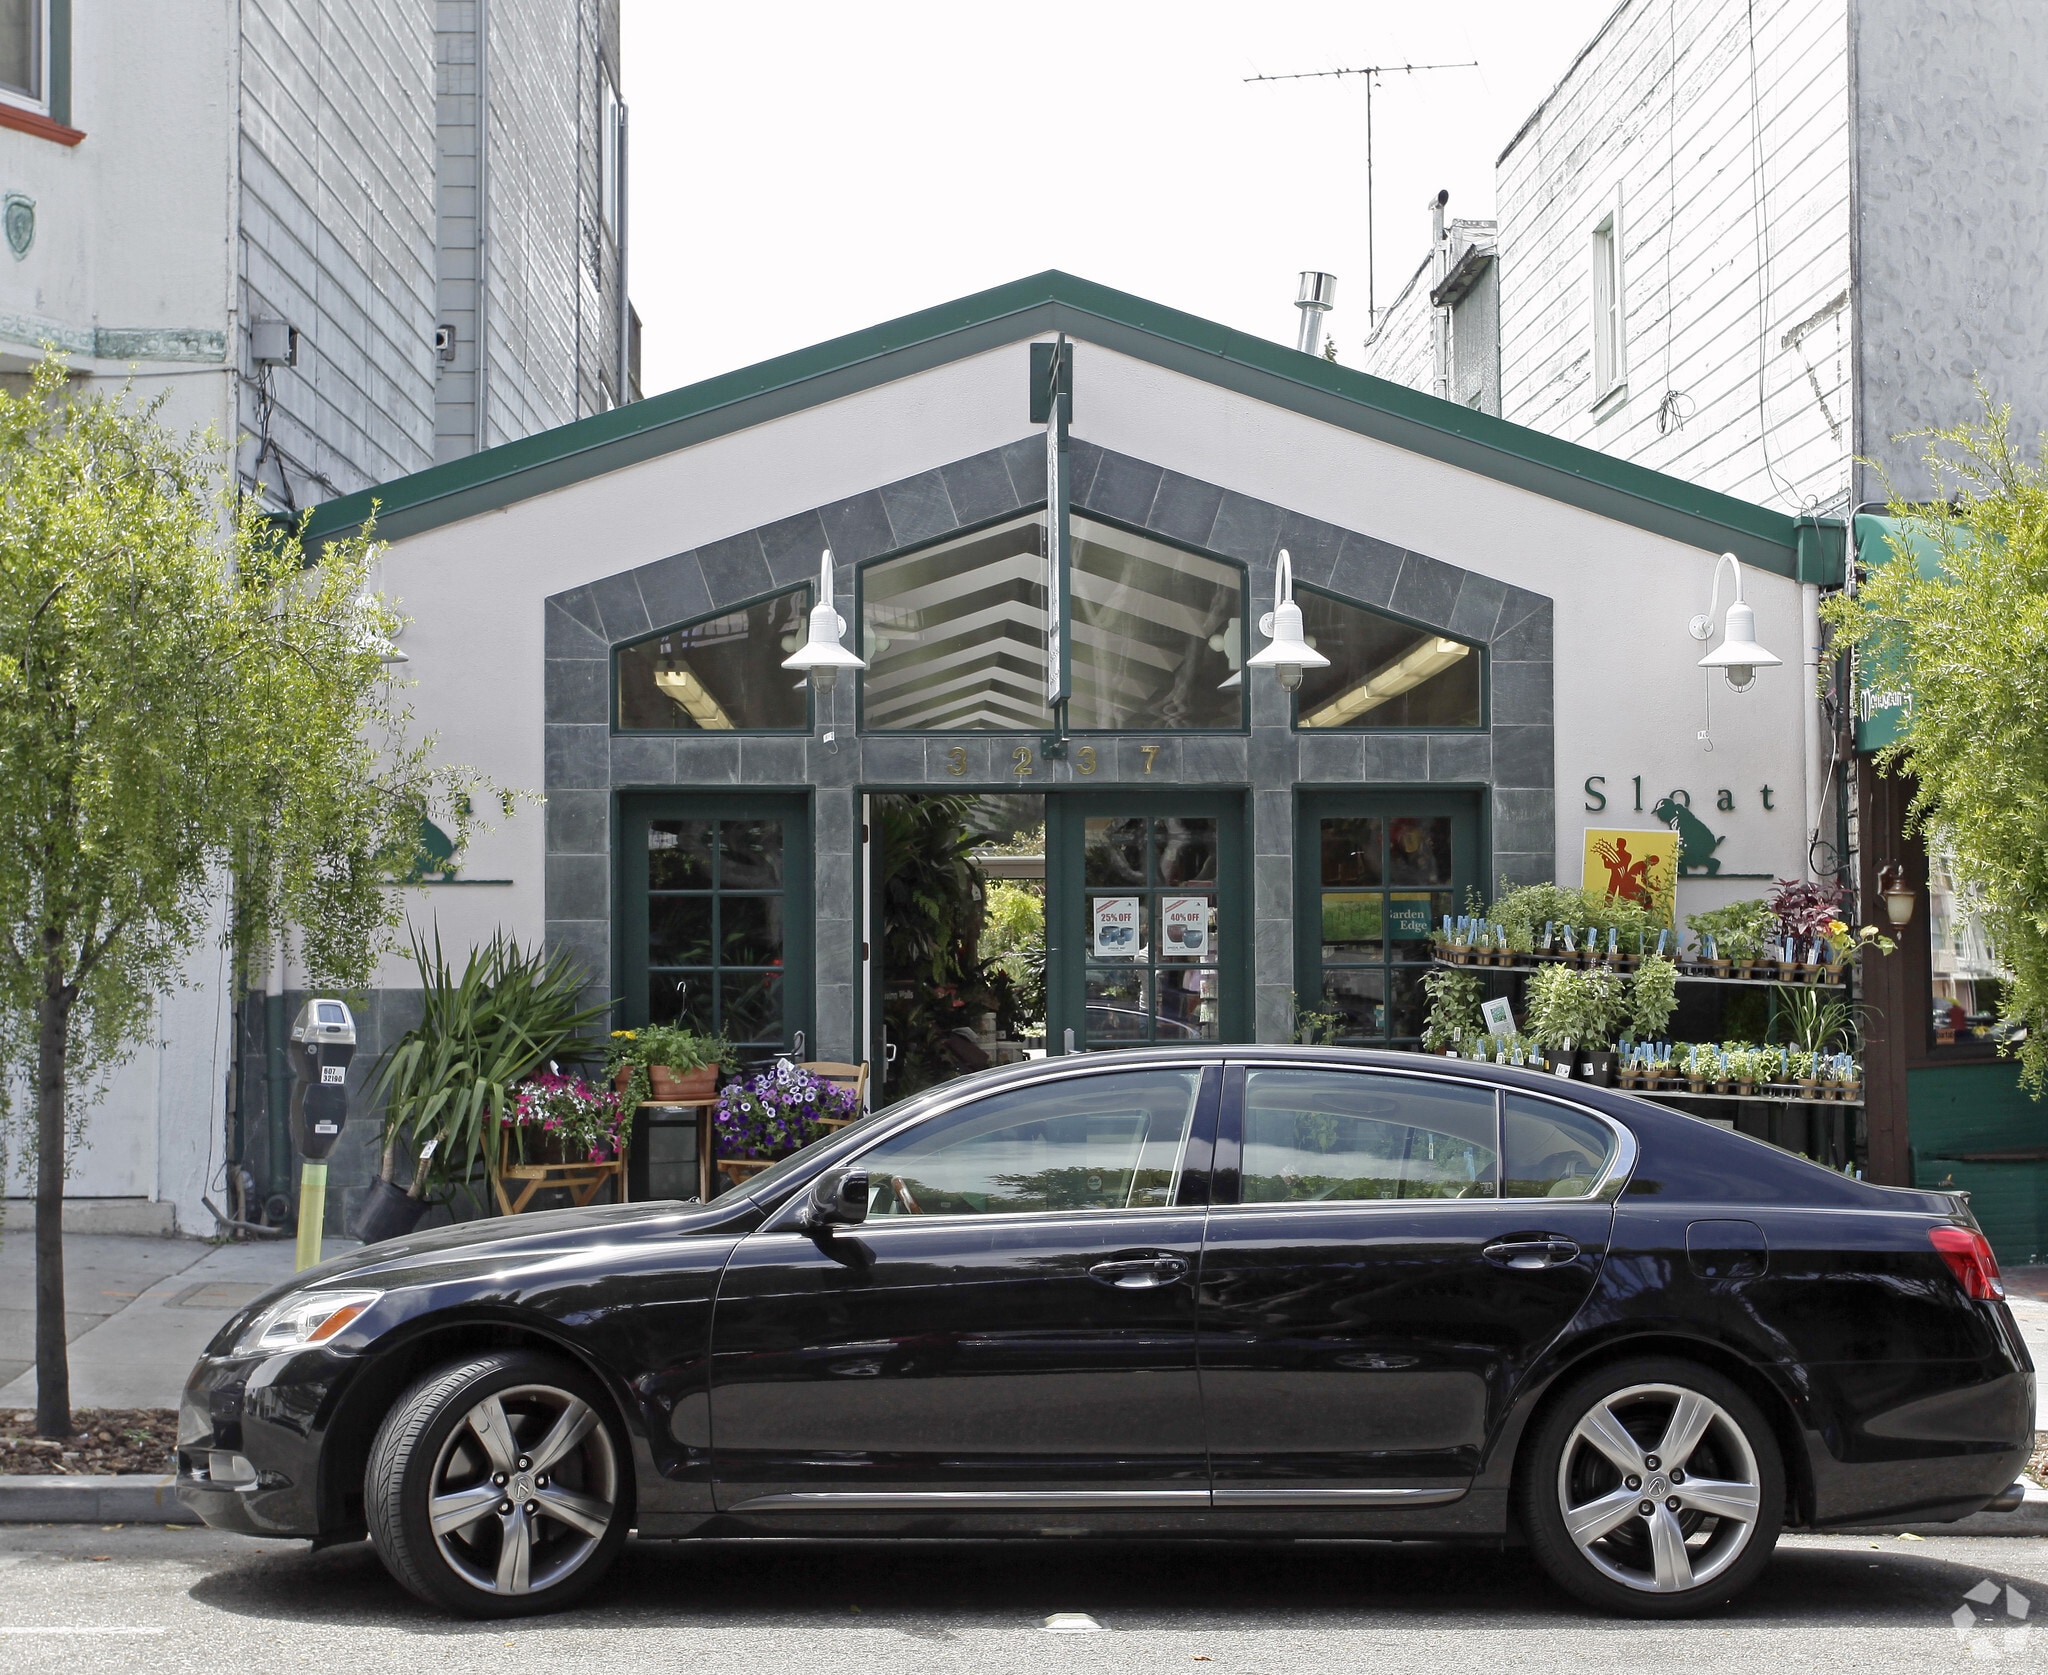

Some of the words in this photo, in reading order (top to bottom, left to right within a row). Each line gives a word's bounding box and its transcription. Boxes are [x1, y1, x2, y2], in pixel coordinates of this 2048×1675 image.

[947, 745, 1160, 776] 3237
[1101, 913, 1118, 923] 25%
[1118, 913, 1133, 923] OFF
[1170, 913, 1186, 923] 40%
[1187, 913, 1200, 923] OFF
[1400, 920, 1428, 934] Edge
